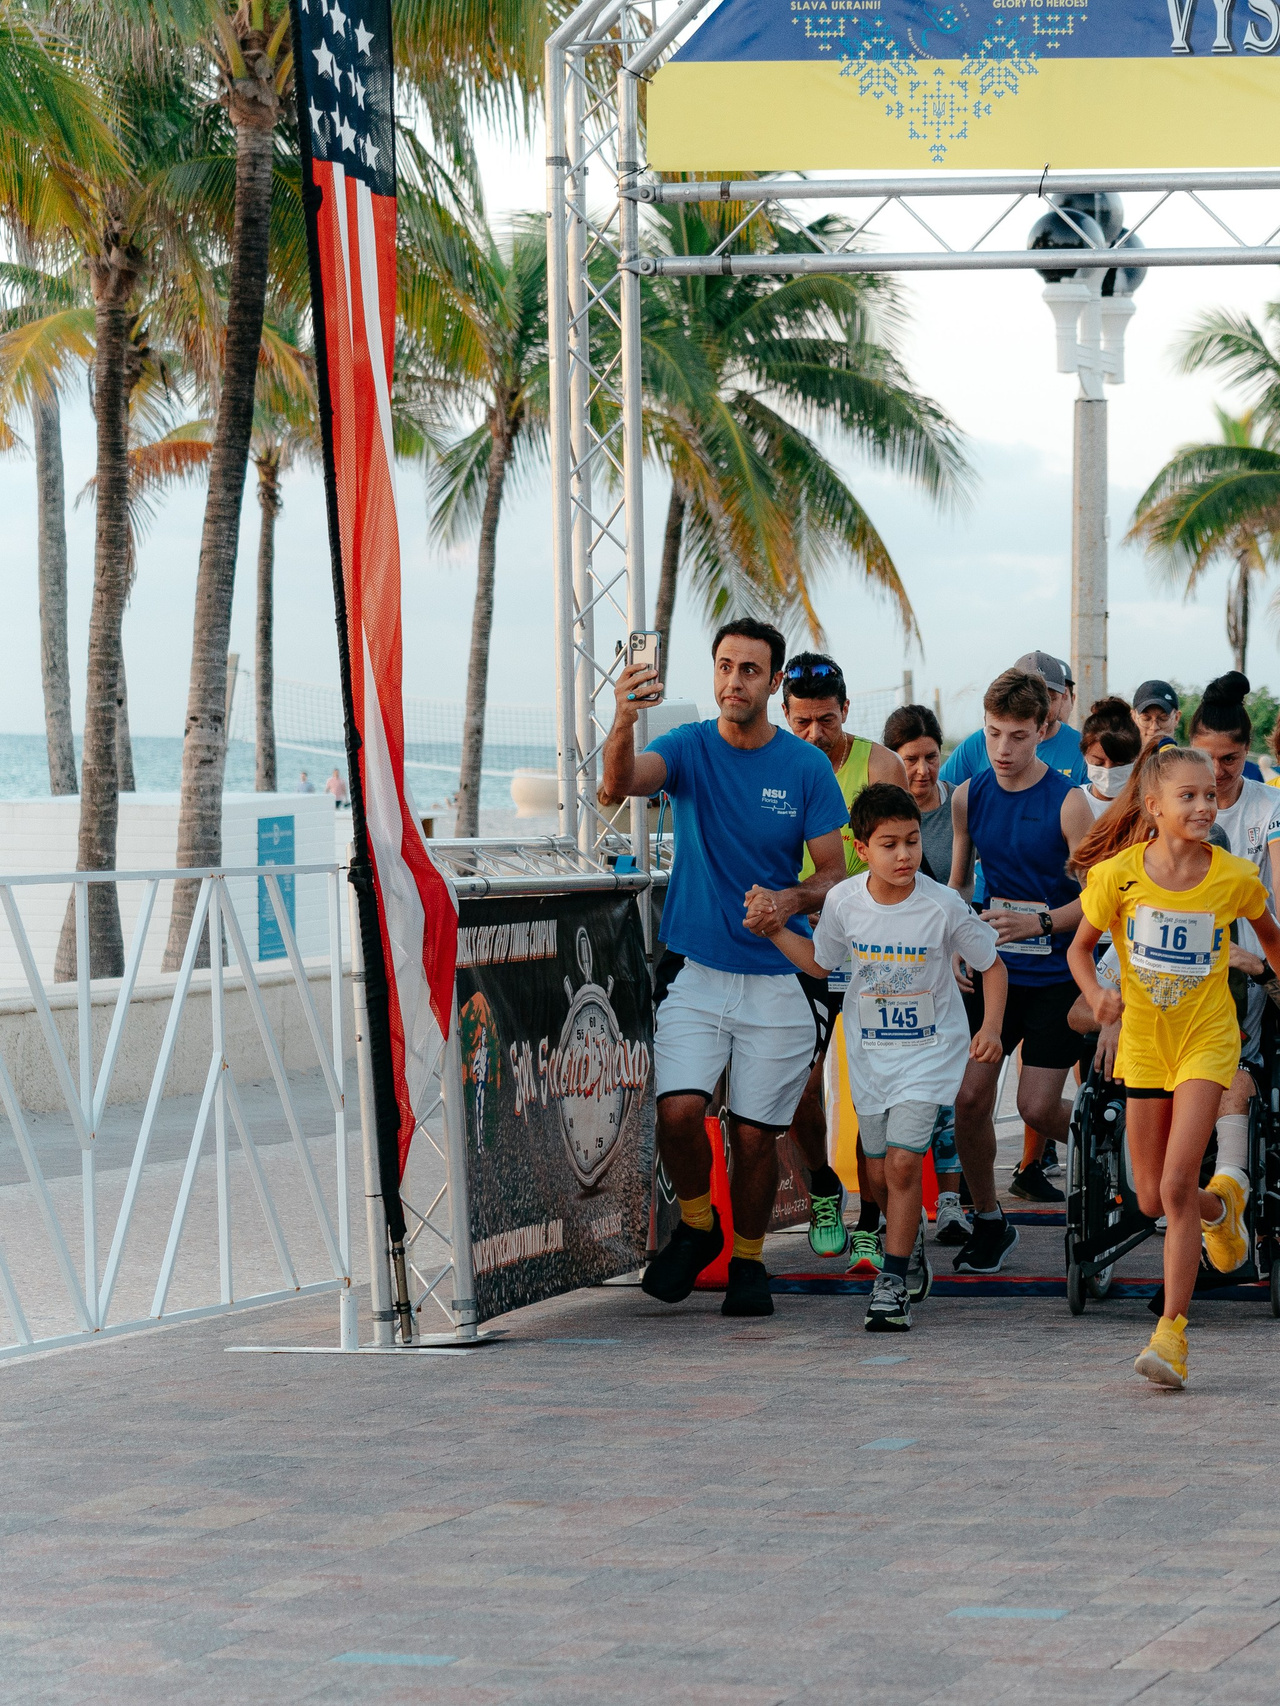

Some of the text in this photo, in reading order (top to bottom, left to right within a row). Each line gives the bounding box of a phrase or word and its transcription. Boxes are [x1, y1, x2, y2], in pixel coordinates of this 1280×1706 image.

[790, 0, 881, 11] SLAVA UKRAINI!
[992, 0, 1088, 8] GLORY TO HEROES!
[762, 788, 787, 799] NSU
[1160, 925, 1188, 950] 16
[852, 941, 927, 962] UKRAINE
[1145, 959, 1162, 968] Coupon
[1104, 967, 1121, 986] Ste
[878, 1007, 918, 1028] 145
